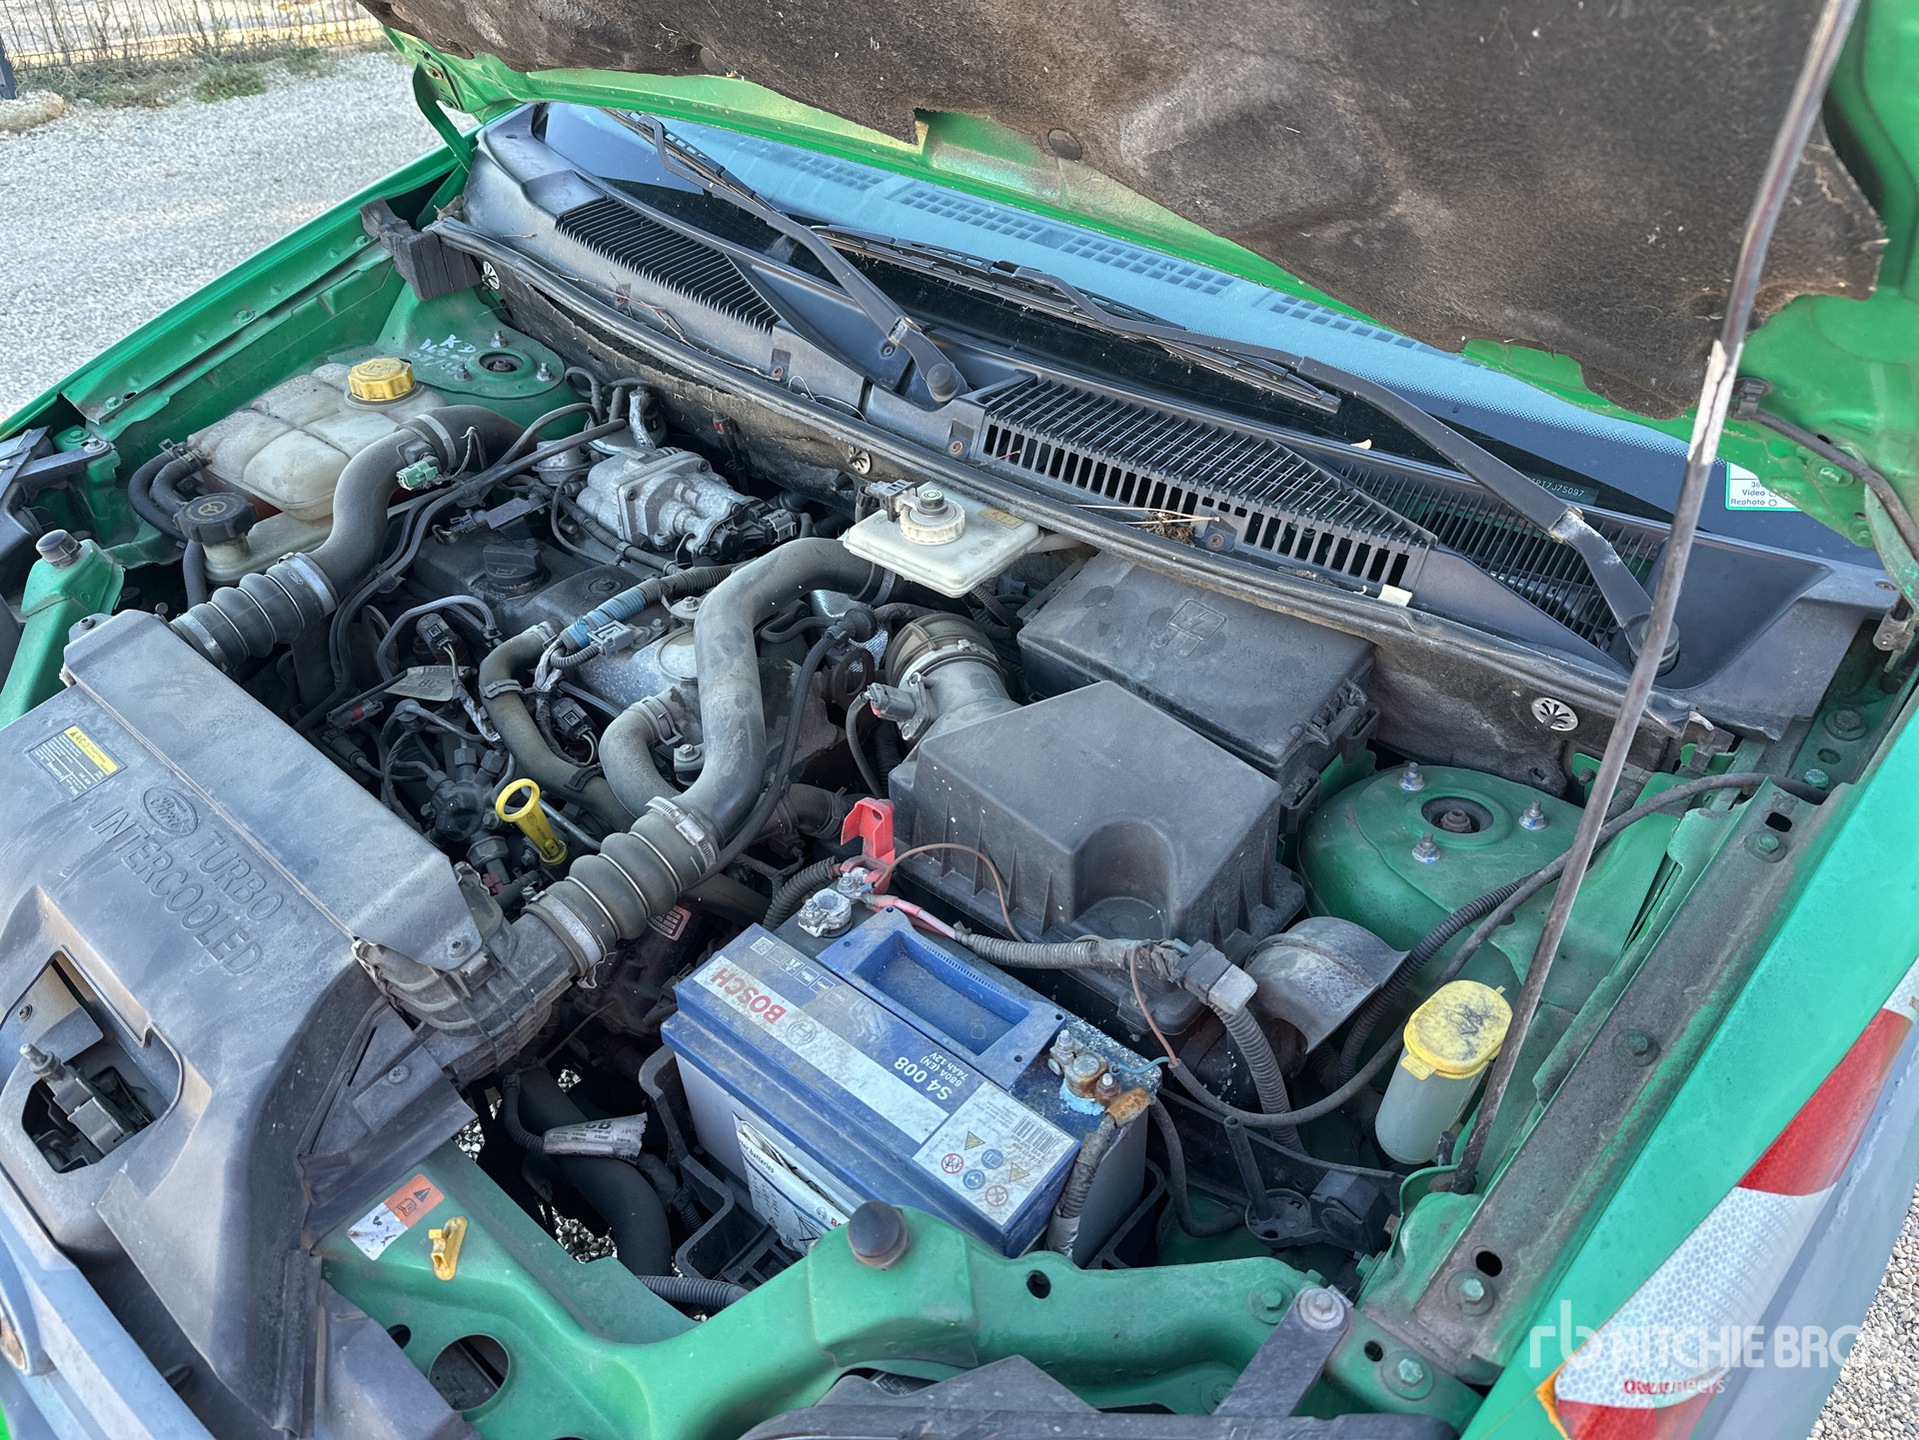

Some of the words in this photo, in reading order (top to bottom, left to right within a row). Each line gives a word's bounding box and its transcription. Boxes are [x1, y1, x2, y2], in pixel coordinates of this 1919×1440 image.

[1731, 498, 1765, 507] Rephoto
[148, 793, 192, 832] Ford
[188, 830, 284, 921] TURBO
[91, 807, 263, 975] INTERCOOLED
[710, 967, 787, 1024] BOSCH
[894, 1057, 928, 1083] 008
[920, 1056, 940, 1072] (EN)
[929, 1052, 947, 1065] 12V
[940, 1069, 962, 1087] 680A
[947, 1062, 969, 1080] 74Ah
[926, 1079, 952, 1100] S4
[749, 1149, 775, 1174] batteries
